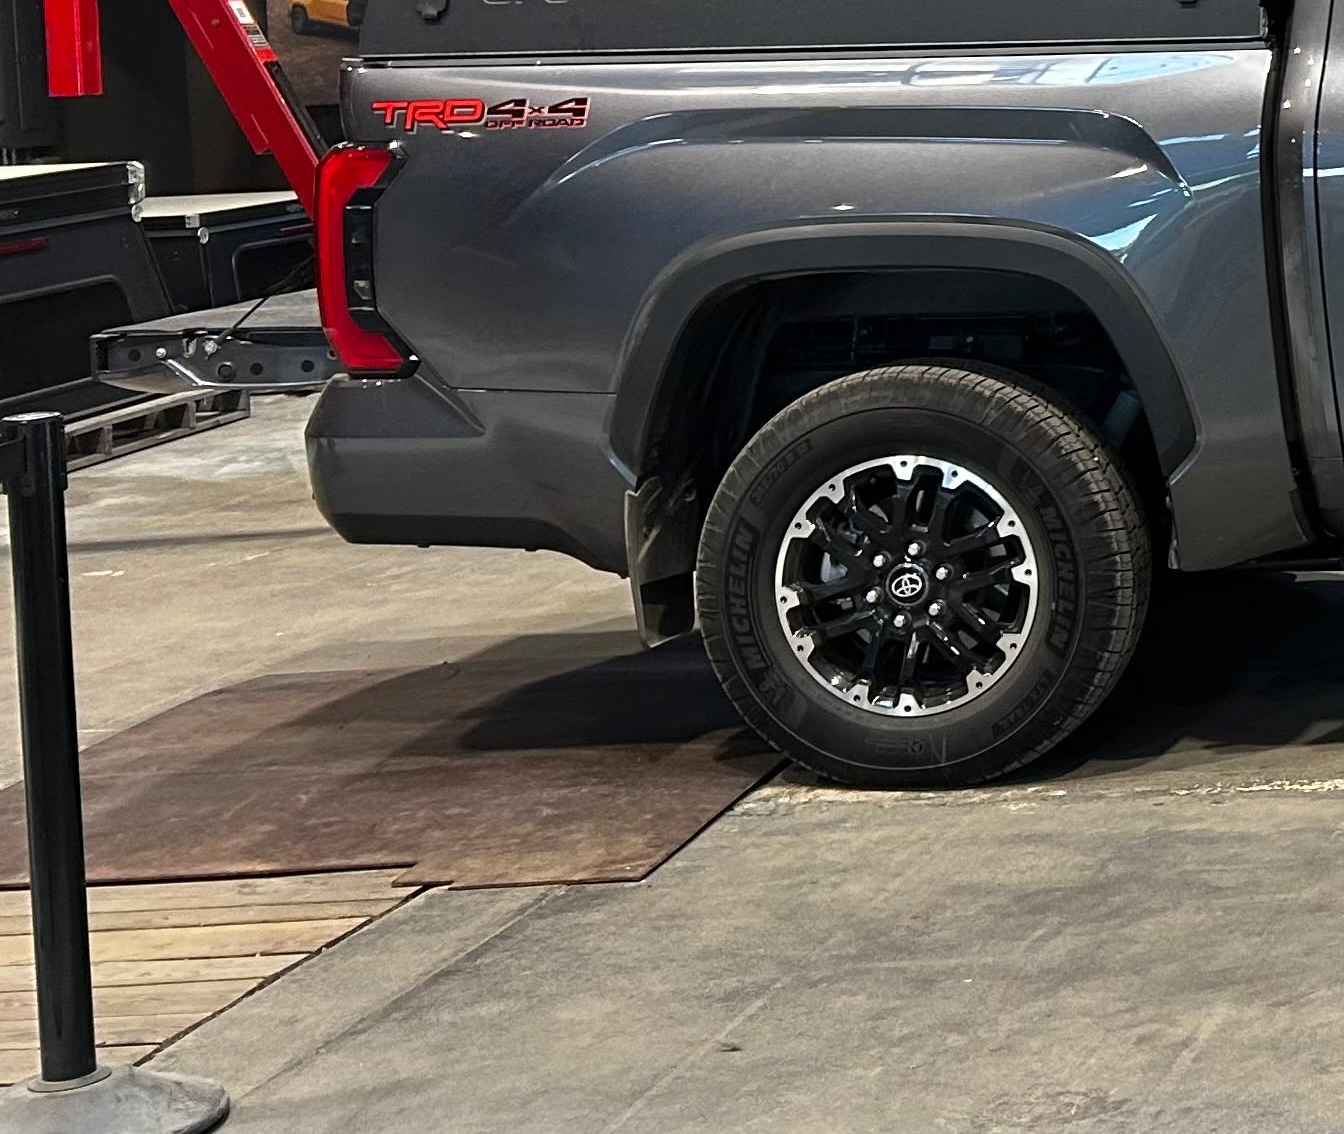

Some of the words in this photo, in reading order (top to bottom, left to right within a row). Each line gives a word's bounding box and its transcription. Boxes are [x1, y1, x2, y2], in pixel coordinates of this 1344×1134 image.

[371, 98, 486, 132] TRD
[484, 118, 525, 130] OFF
[527, 117, 586, 129] ROAD
[729, 523, 766, 674] MICHELIN
[1040, 502, 1075, 653] MICHELIN
